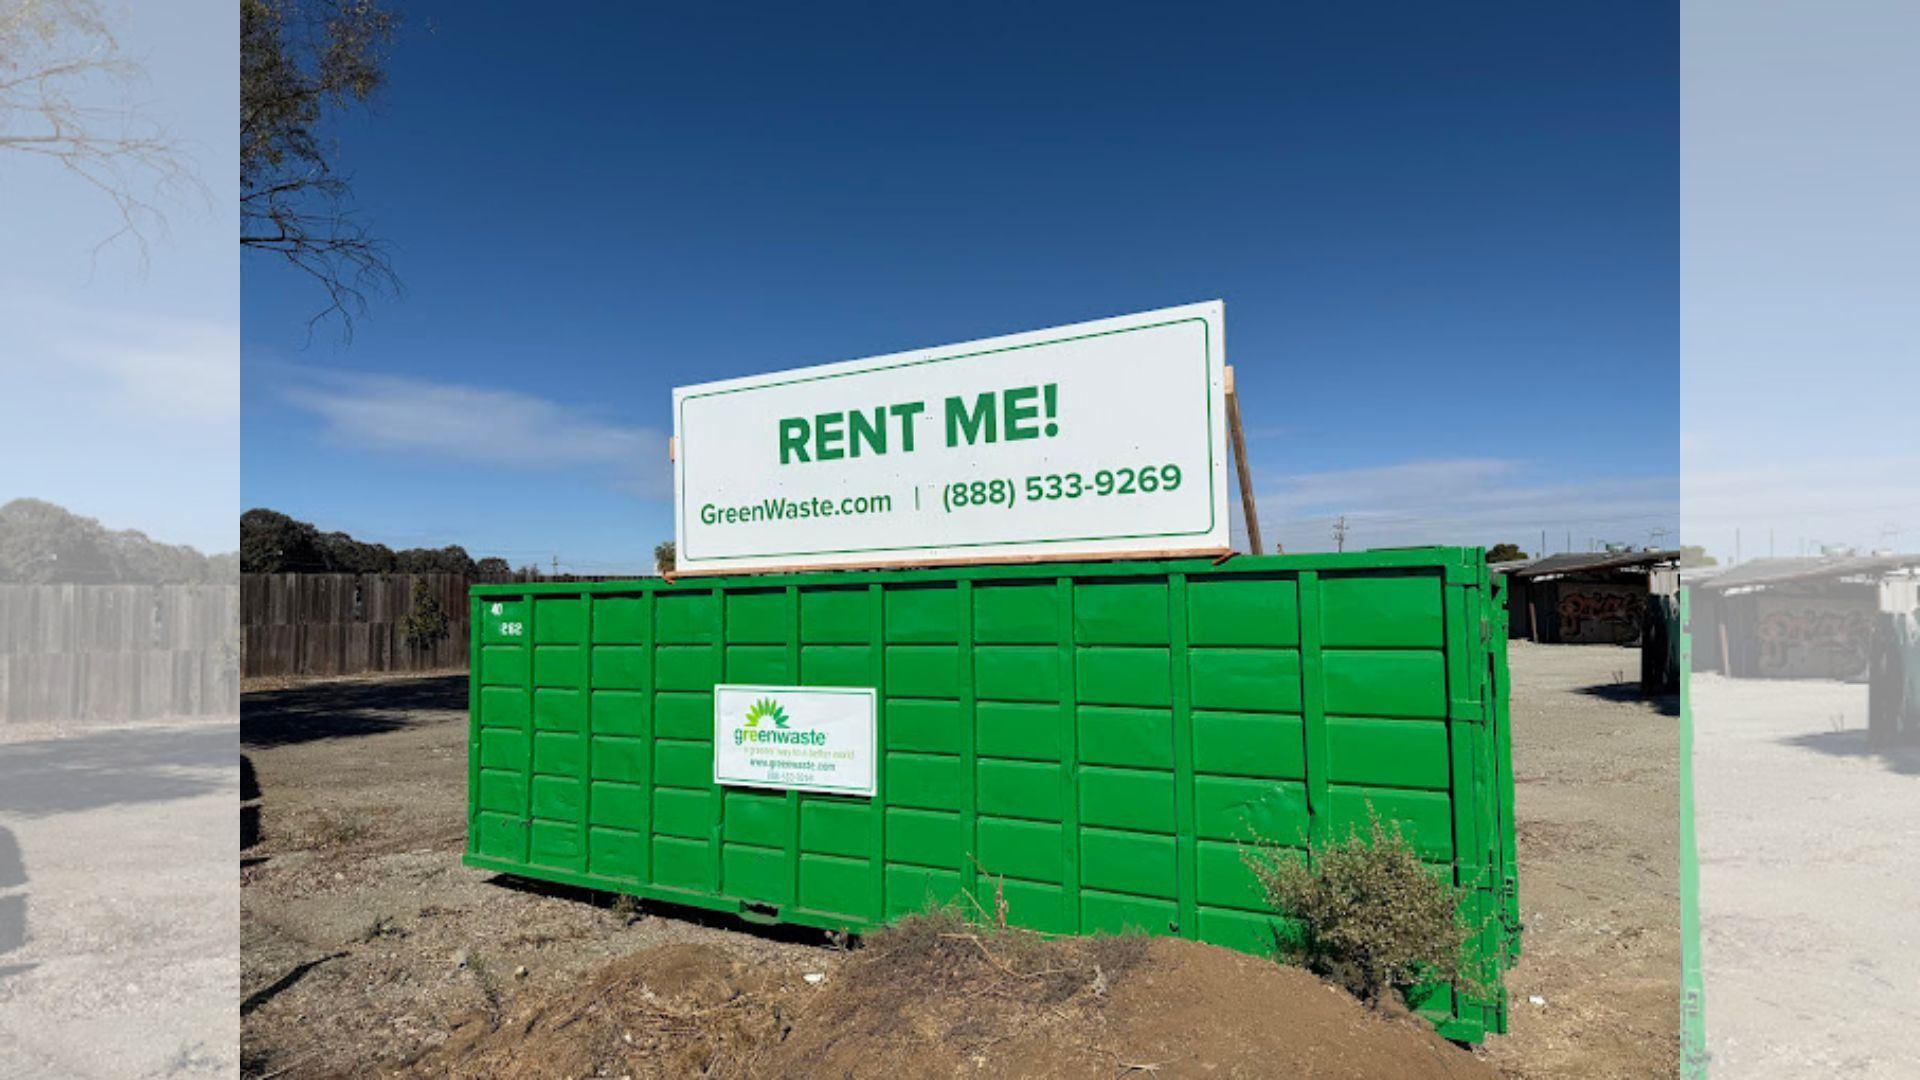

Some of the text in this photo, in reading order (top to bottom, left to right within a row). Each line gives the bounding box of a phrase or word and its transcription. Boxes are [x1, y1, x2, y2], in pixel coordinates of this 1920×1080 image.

[778, 383, 1059, 466] RENT ME!
[700, 463, 1183, 526] GreenWaste.com (888) 533-9269
[734, 726, 826, 746] greenwaste
